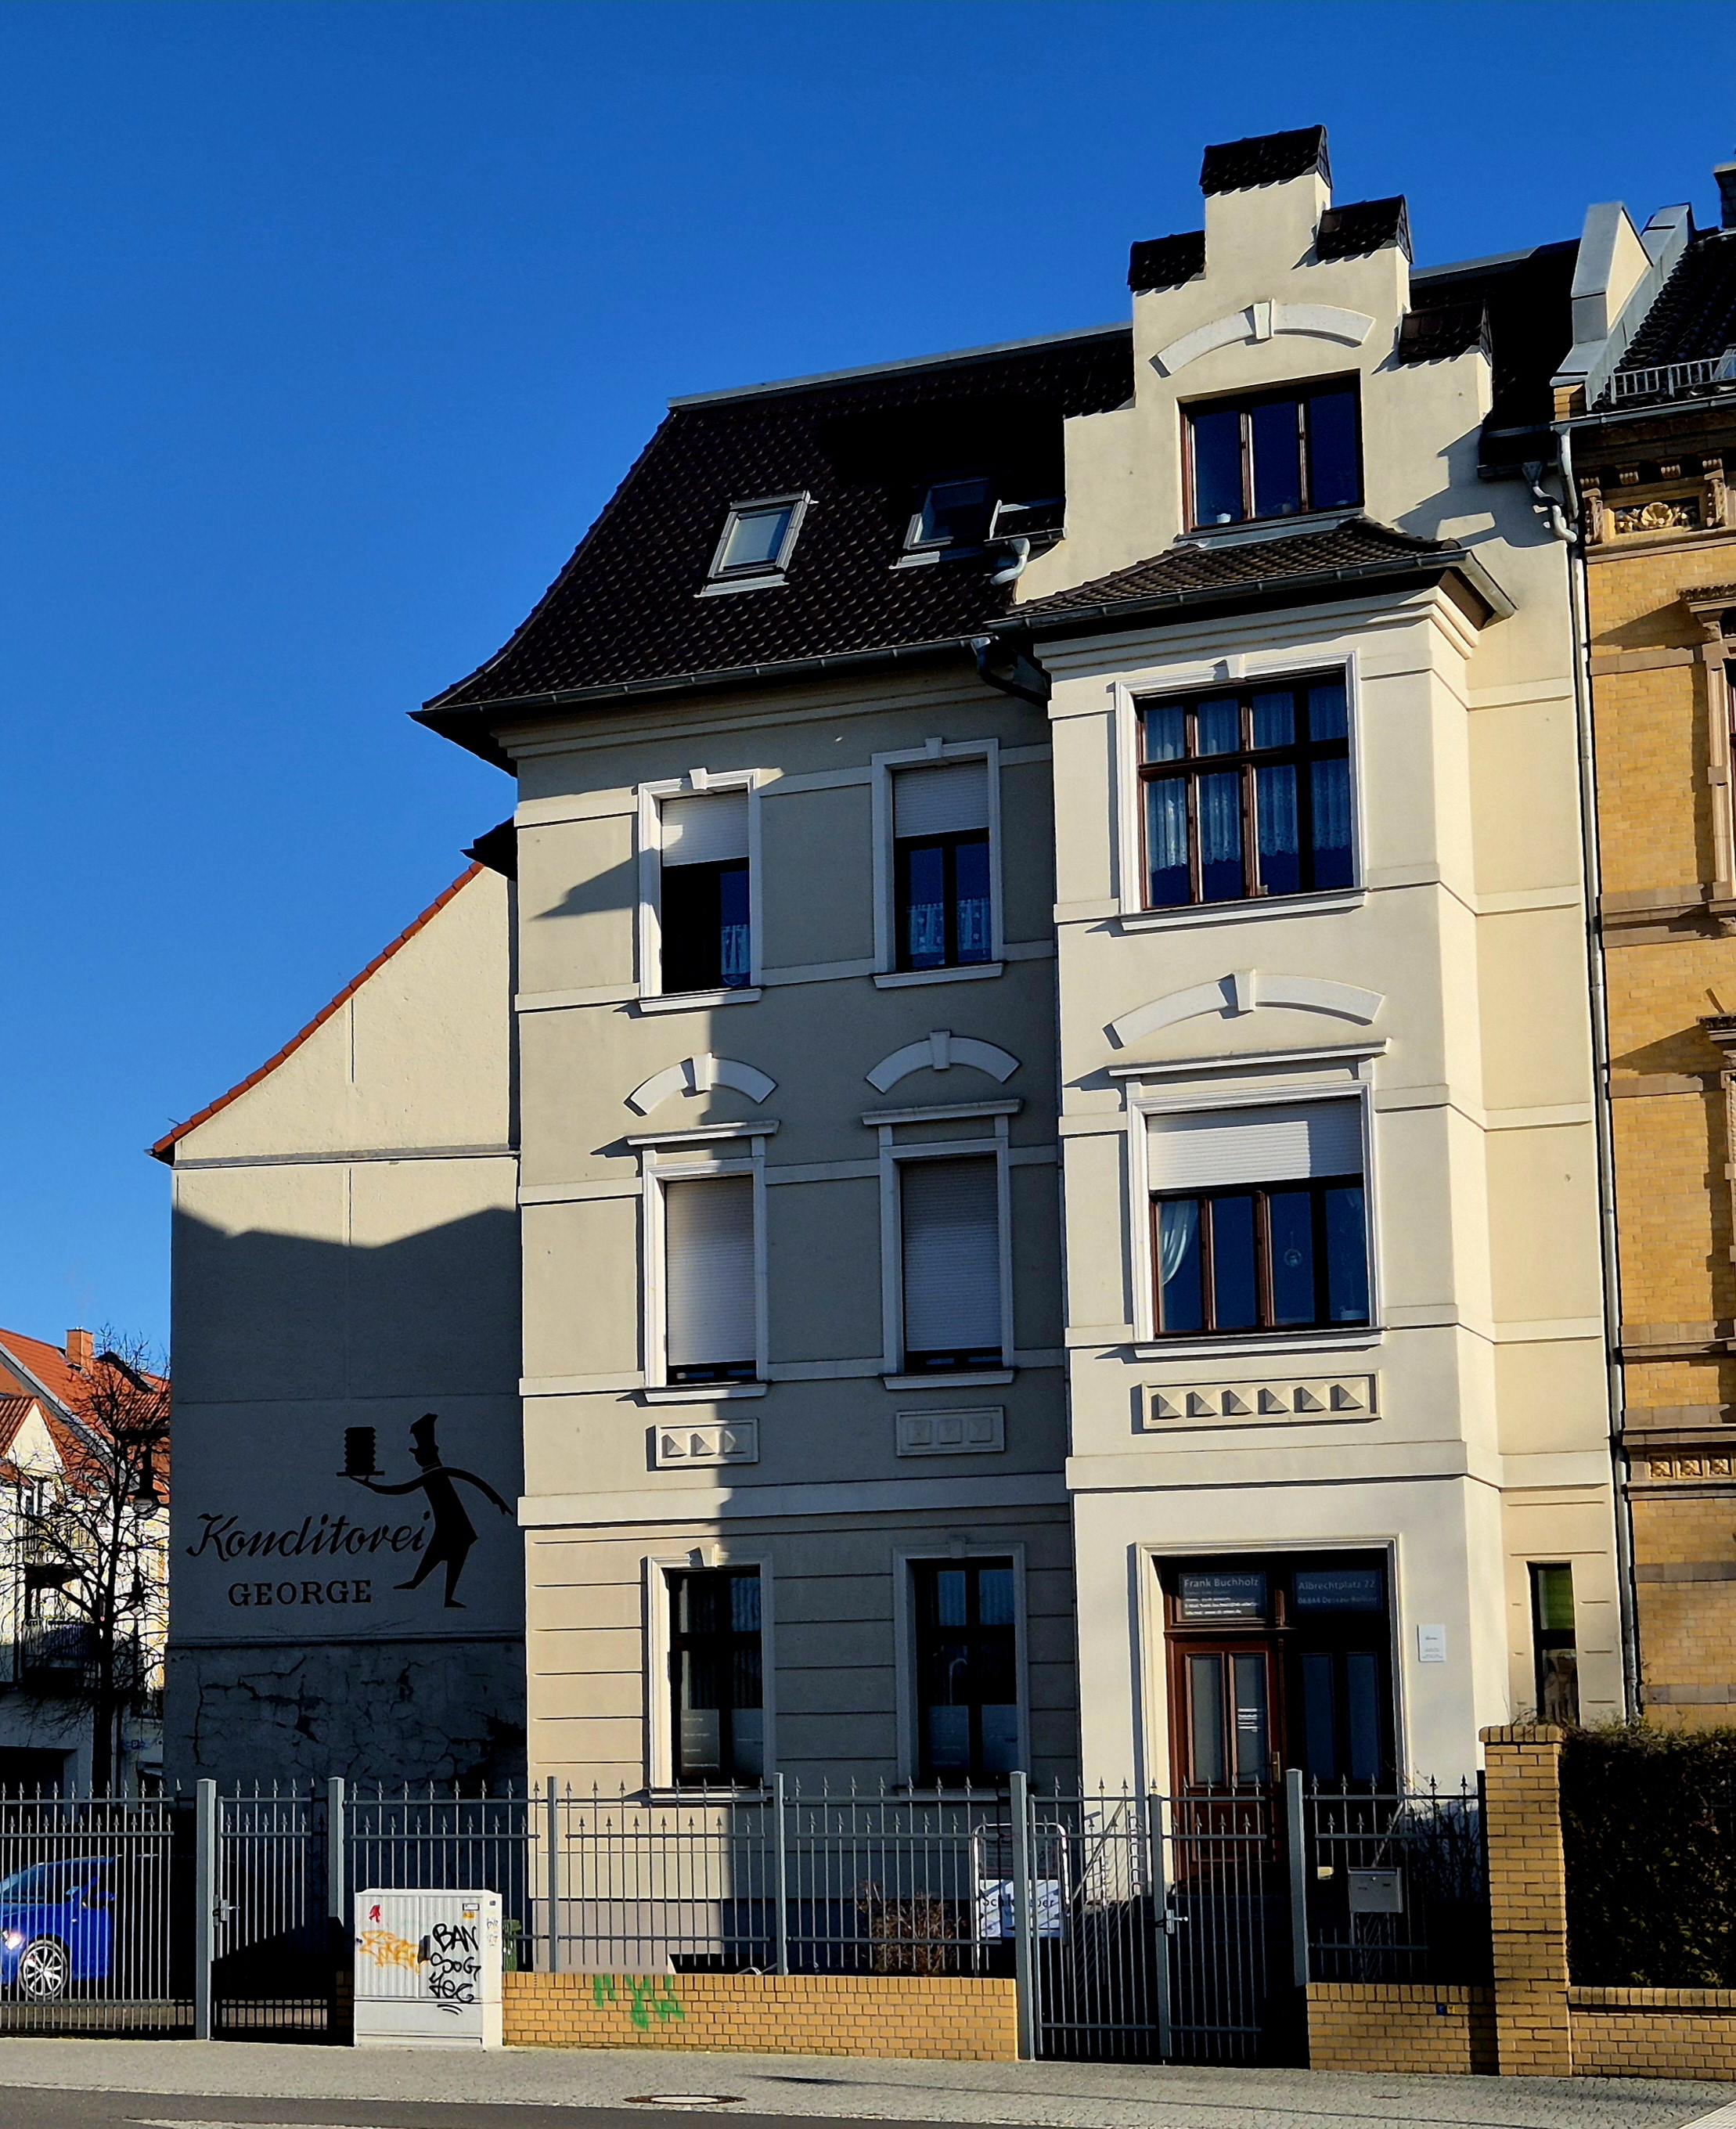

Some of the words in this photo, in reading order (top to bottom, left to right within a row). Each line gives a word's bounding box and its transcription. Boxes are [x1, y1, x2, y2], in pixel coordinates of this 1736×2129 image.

[186, 1511, 430, 1562] Konditorei
[228, 1580, 372, 1607] GEORGE
[1183, 1578, 1212, 1587] Frank
[1214, 1577, 1259, 1587] Buchholz
